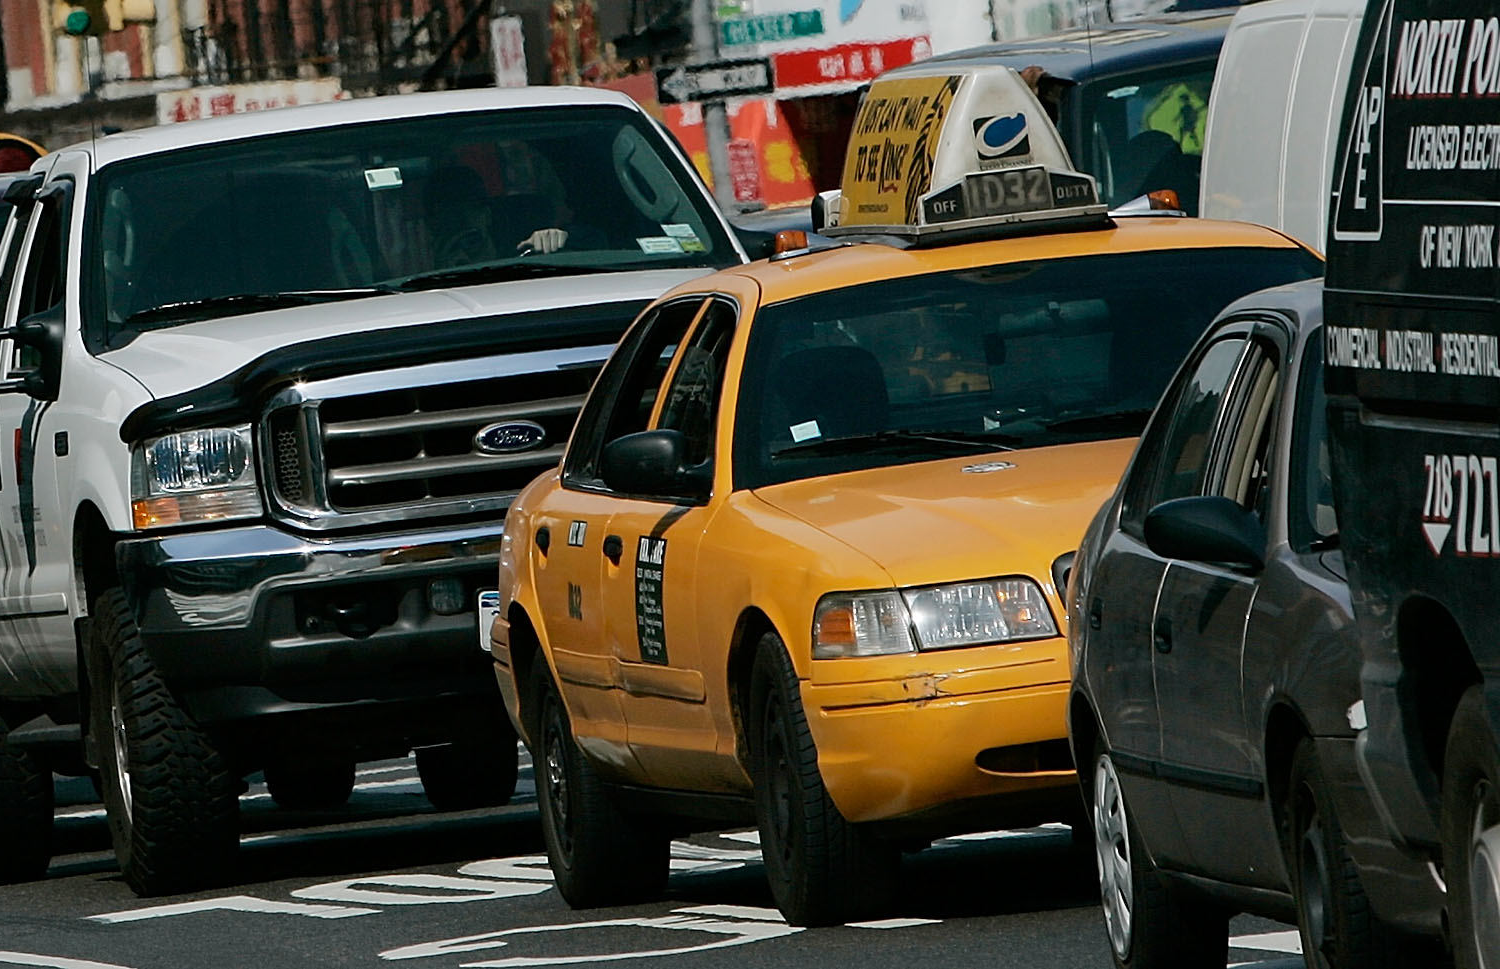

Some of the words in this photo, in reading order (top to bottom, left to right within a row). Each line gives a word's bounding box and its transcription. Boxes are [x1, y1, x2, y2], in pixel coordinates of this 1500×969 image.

[1392, 18, 1466, 96] NORTH
[1406, 125, 1461, 171] LICENSED
[933, 199, 958, 215] OFF
[1056, 184, 1090, 200] DUTY
[1420, 226, 1437, 268] OF
[1437, 226, 1464, 269] NEW
[1464, 226, 1495, 269] YORK
[1327, 326, 1381, 370] COMMERCIAL
[1385, 330, 1437, 374] INDUSTRIAL
[494, 428, 531, 445] Ford
[1423, 454, 1453, 519] 718
